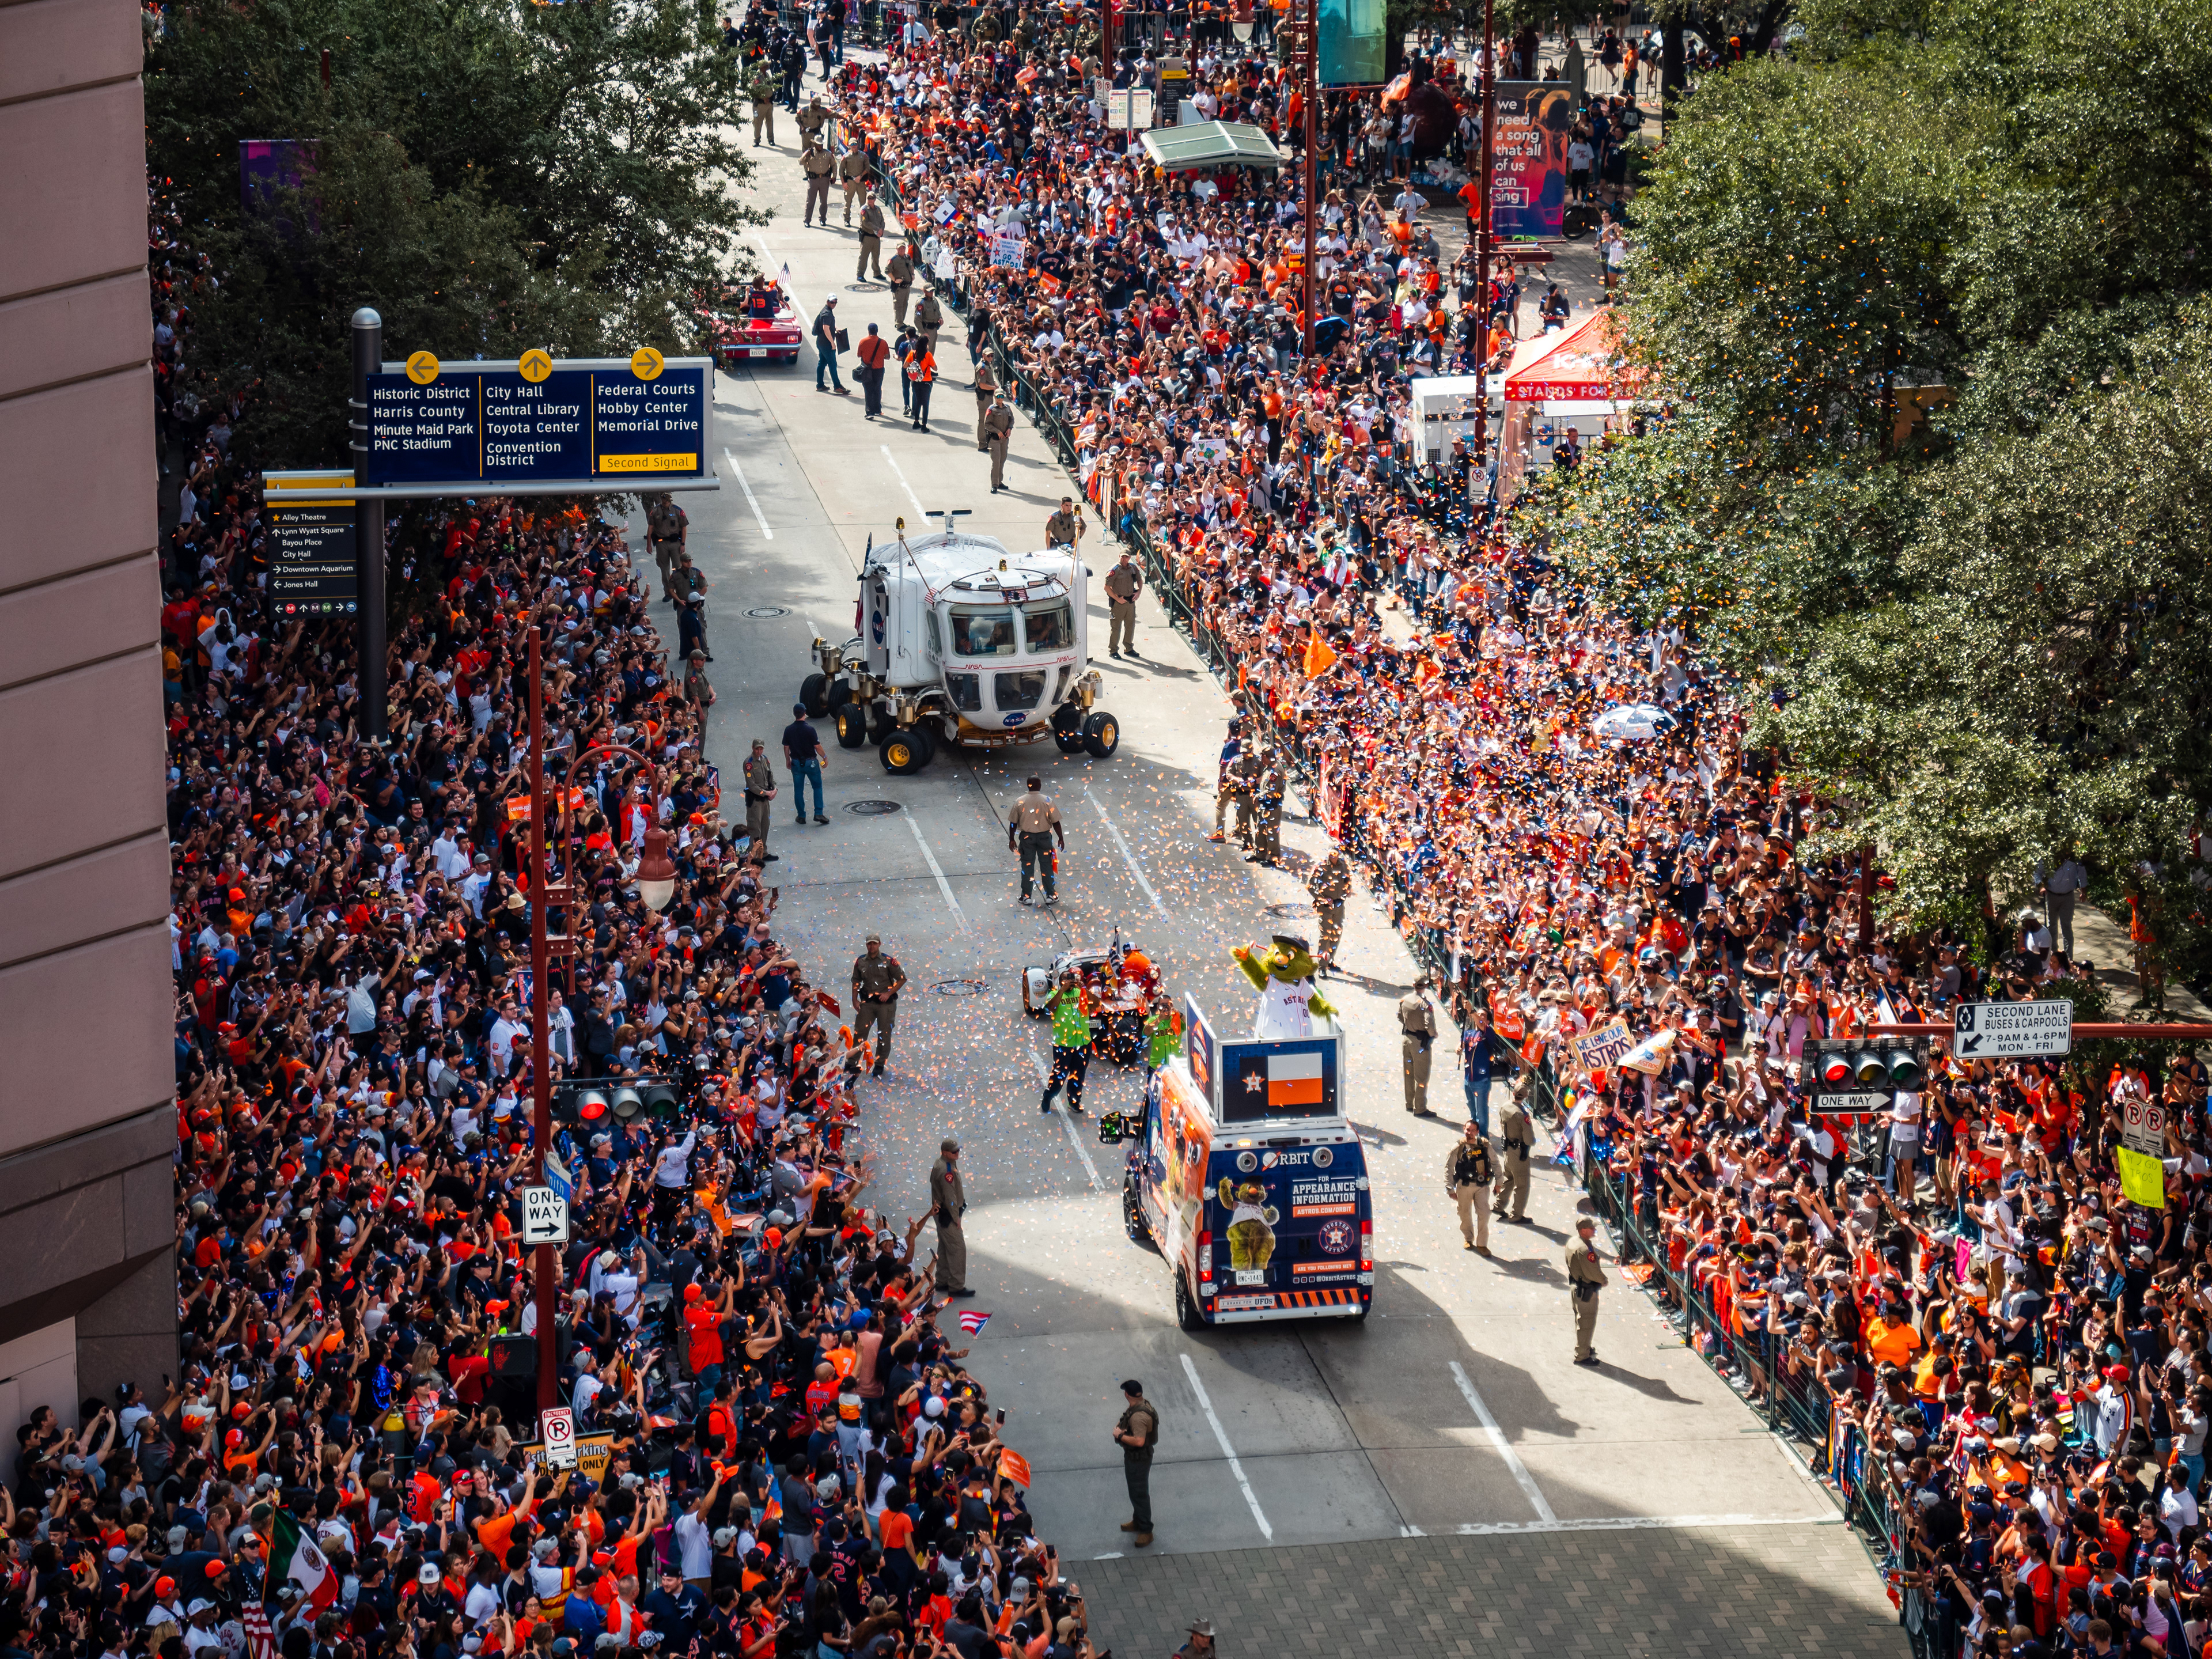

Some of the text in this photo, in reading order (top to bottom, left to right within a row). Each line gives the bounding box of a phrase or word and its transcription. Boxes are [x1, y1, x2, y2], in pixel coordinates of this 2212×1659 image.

[1497, 100, 1517, 109] we
[1497, 113, 1529, 125] need
[1496, 132, 1539, 143] a song
[1496, 144, 1541, 156] that all
[1495, 159, 1525, 171] of us
[1495, 177, 1517, 187] can
[1495, 192, 1520, 204] sing
[993, 259, 1021, 269] ASTROS!
[752, 298, 766, 308] 13
[374, 388, 469, 399] Historic District
[487, 386, 543, 400] City Hall
[599, 384, 695, 396] Federal Courts
[1518, 386, 1573, 396] STANDS
[1581, 385, 1607, 396] FOR
[374, 407, 465, 419] Harris County
[487, 404, 579, 417] Central Library
[599, 403, 688, 416] Hobby Center
[374, 423, 474, 435] Minute Maid Park
[487, 423, 579, 436] Toyota Center
[599, 419, 698, 431] Memorial Drive
[374, 438, 451, 450] PNC Stadium
[487, 442, 560, 453] Convention
[487, 454, 534, 465] District
[607, 456, 688, 469] Second Signal
[282, 528, 297, 536] Lynn
[873, 620, 884, 633] NASA
[200, 897, 221, 908] STROS
[1987, 1005, 2066, 1018] SECOND LANE
[1985, 1016, 2068, 1030] BUSES & CARPOOLS
[1575, 1025, 1625, 1051] WE LOVE OUR
[1986, 1031, 2067, 1043] 7-9AM & 4-6PM
[1582, 1037, 1632, 1069] ASTROS
[1998, 1043, 2024, 1052] MON
[2036, 1042, 2053, 1050] FRI
[1247, 1076, 1261, 1090] H
[1822, 1096, 1873, 1106] ONE WAY
[2145, 1160, 2157, 1170] GO
[2121, 1167, 2153, 1183] ASTROS
[1293, 1182, 1355, 1194] APPEARANCE
[529, 1191, 562, 1204] ONE
[1293, 1193, 1355, 1205] INFORMATION
[529, 1206, 562, 1219] WAY
[1297, 1206, 1351, 1215] ASTROS.COM/ORBIT
[2133, 1213, 2147, 1222] WORLD
[1323, 1222, 1350, 1232] HOUSTON
[2133, 1222, 2146, 1231] SERIES
[1331, 1232, 1342, 1244] H
[1324, 1244, 1349, 1253] ASTROS
[843, 1358, 852, 1374] 7
[807, 1391, 830, 1400] ALVAREZ
[577, 1444, 608, 1457] rking
[582, 1459, 605, 1471] ONLY
[407, 1491, 417, 1515] 2
[834, 1562, 847, 1582] 2
